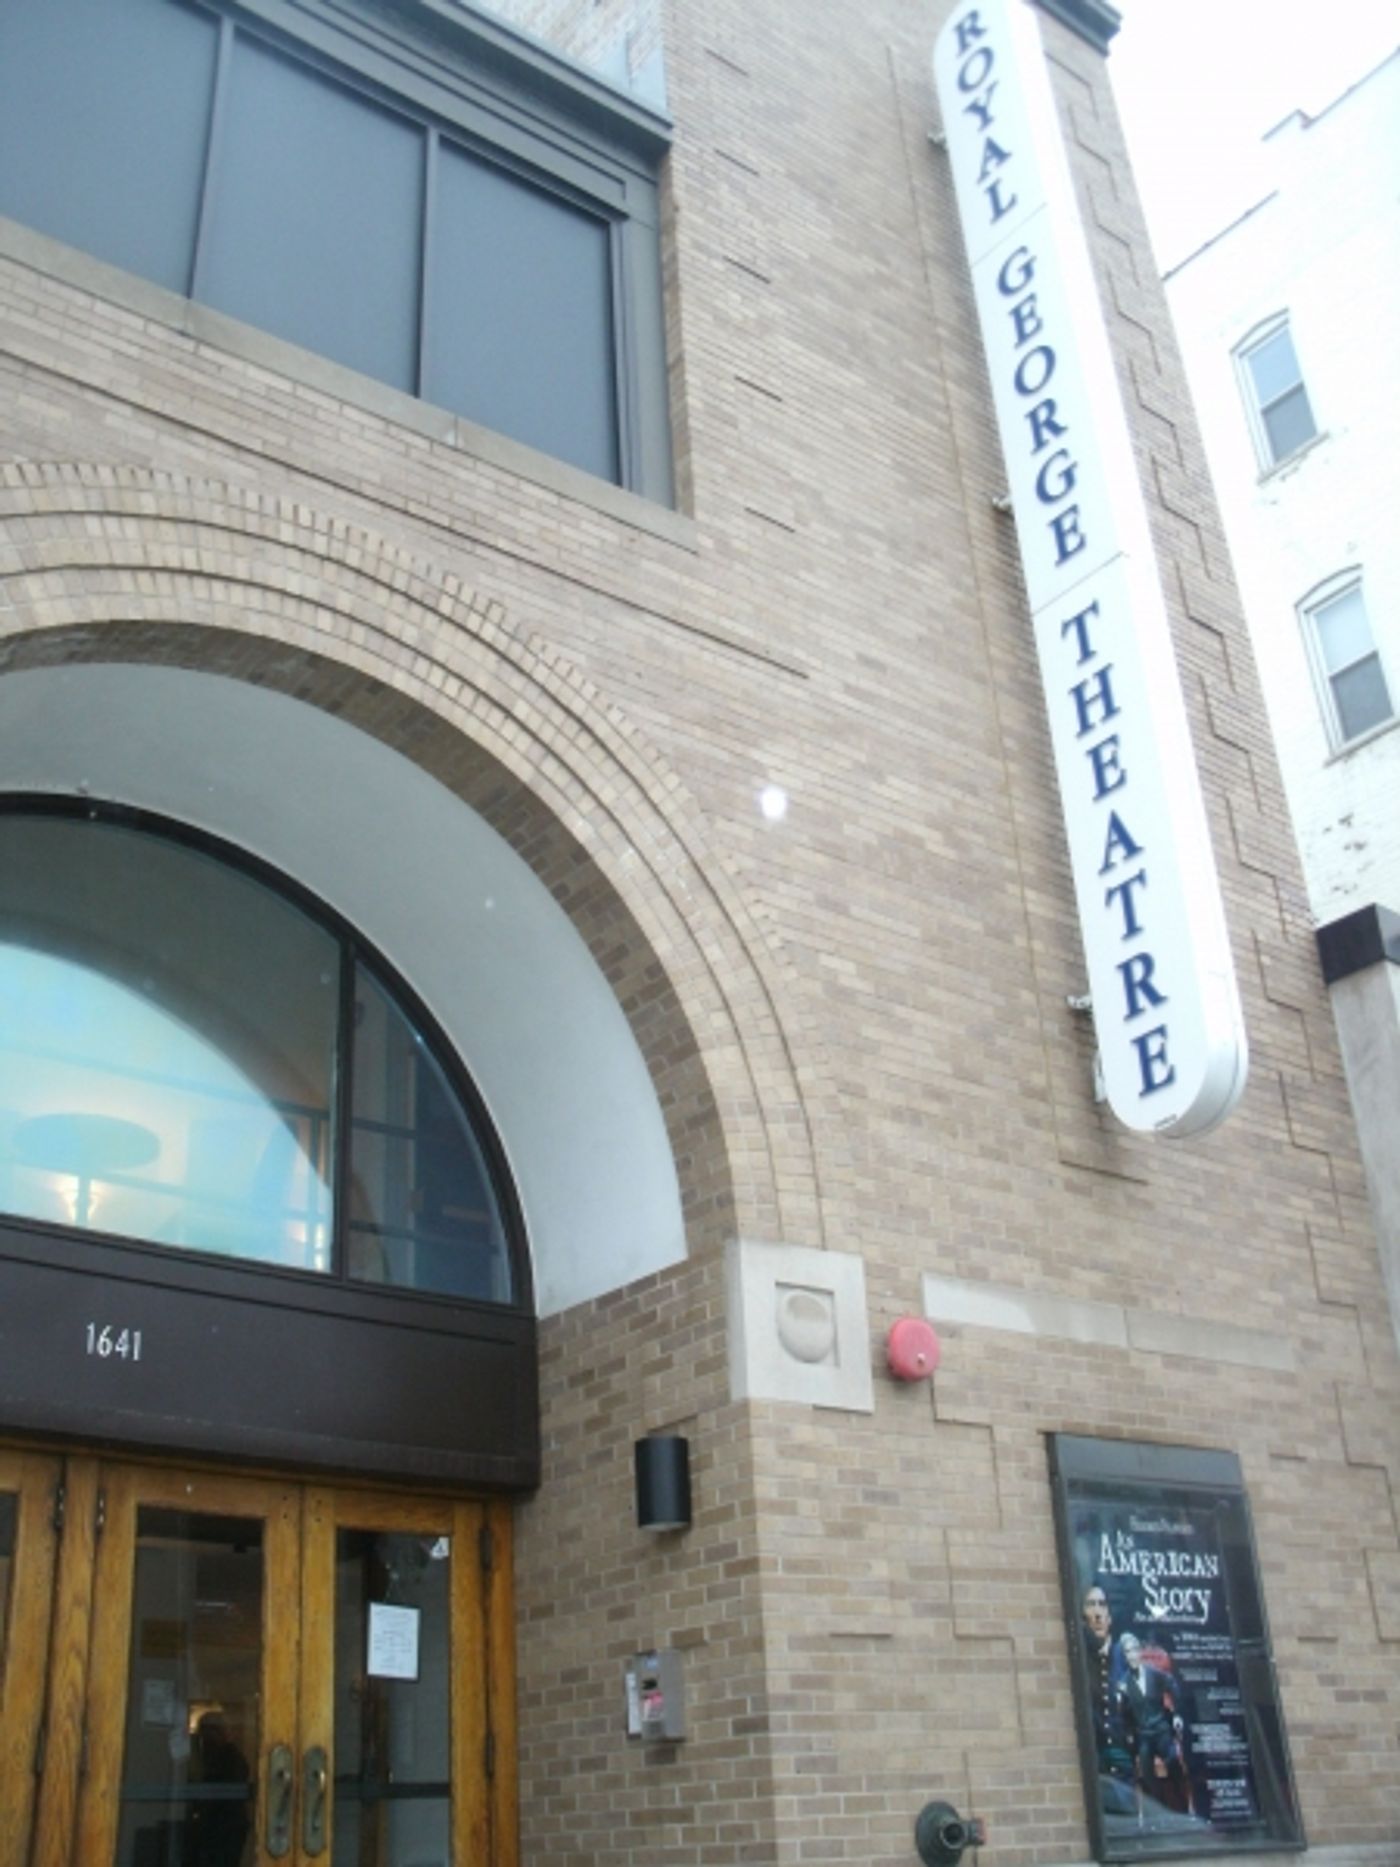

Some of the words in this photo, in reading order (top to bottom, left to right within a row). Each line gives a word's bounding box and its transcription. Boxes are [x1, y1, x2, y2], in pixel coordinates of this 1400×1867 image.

[954, 9, 1018, 224] ROYAL
[996, 245, 1087, 568] GEORGE
[1061, 599, 1175, 1099] THEATRE
[86, 1322, 141, 1361] 1641
